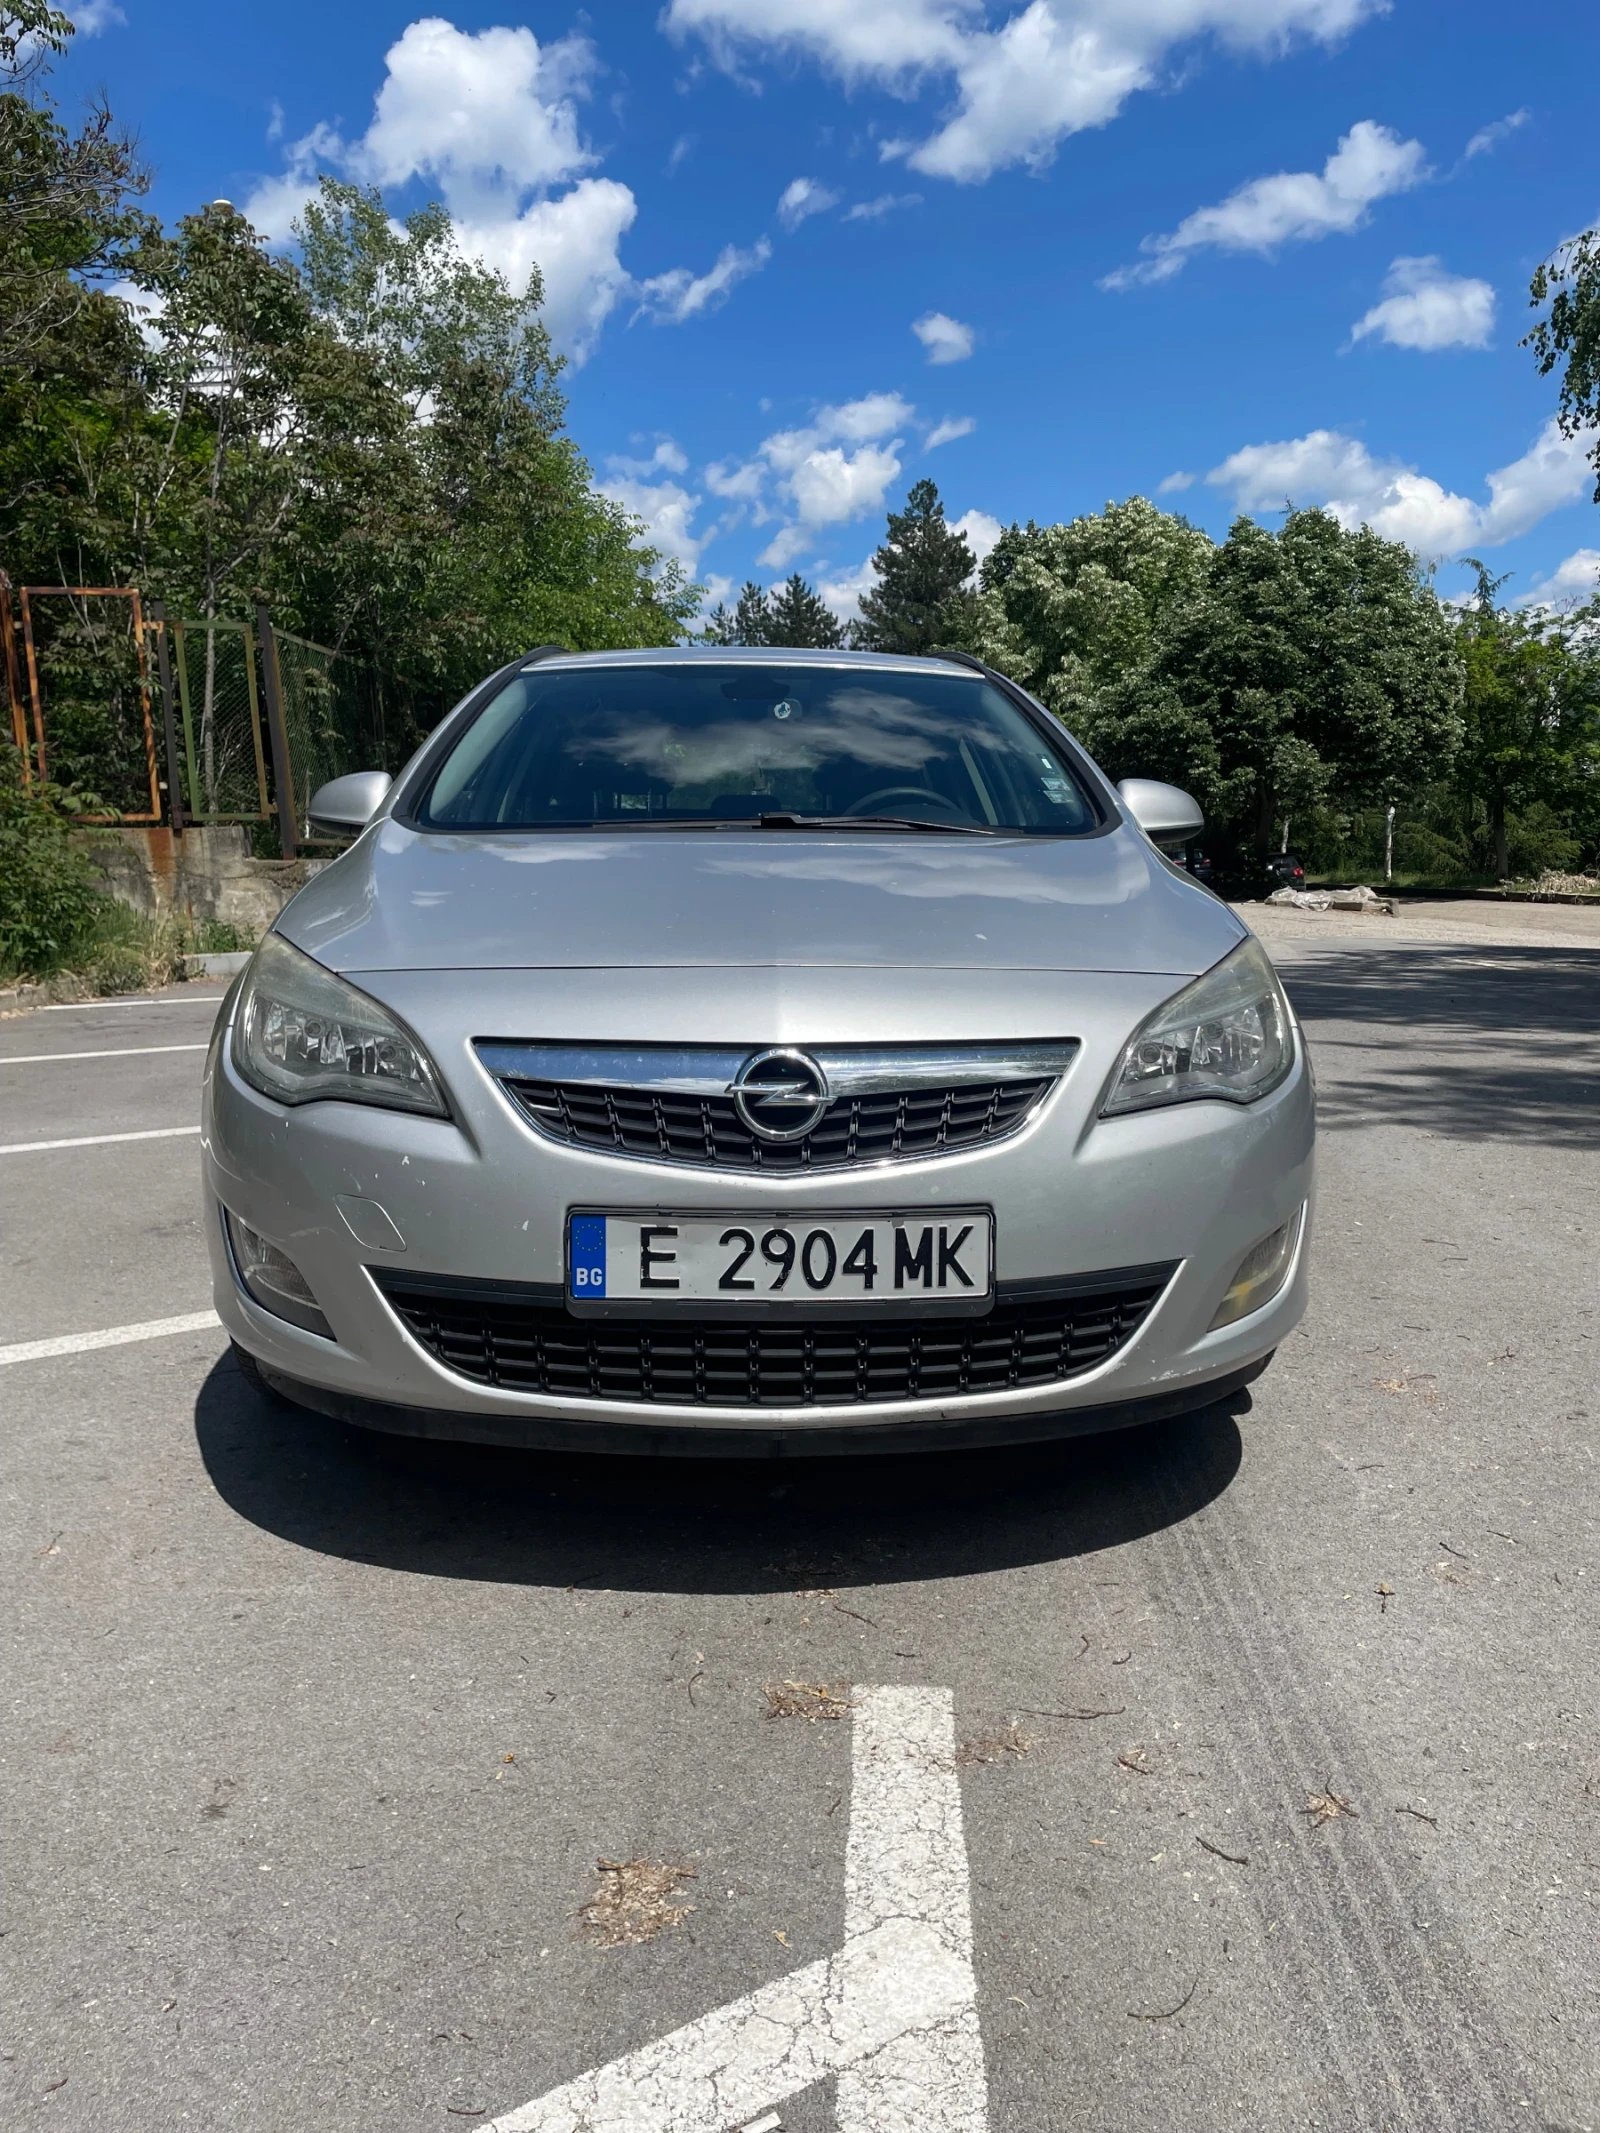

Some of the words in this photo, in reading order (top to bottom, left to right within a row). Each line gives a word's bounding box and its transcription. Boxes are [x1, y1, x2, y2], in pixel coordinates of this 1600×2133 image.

[576, 1267, 603, 1286] BG
[640, 1226, 680, 1289] E
[718, 1228, 878, 1290] 2904
[894, 1225, 975, 1289] MK
